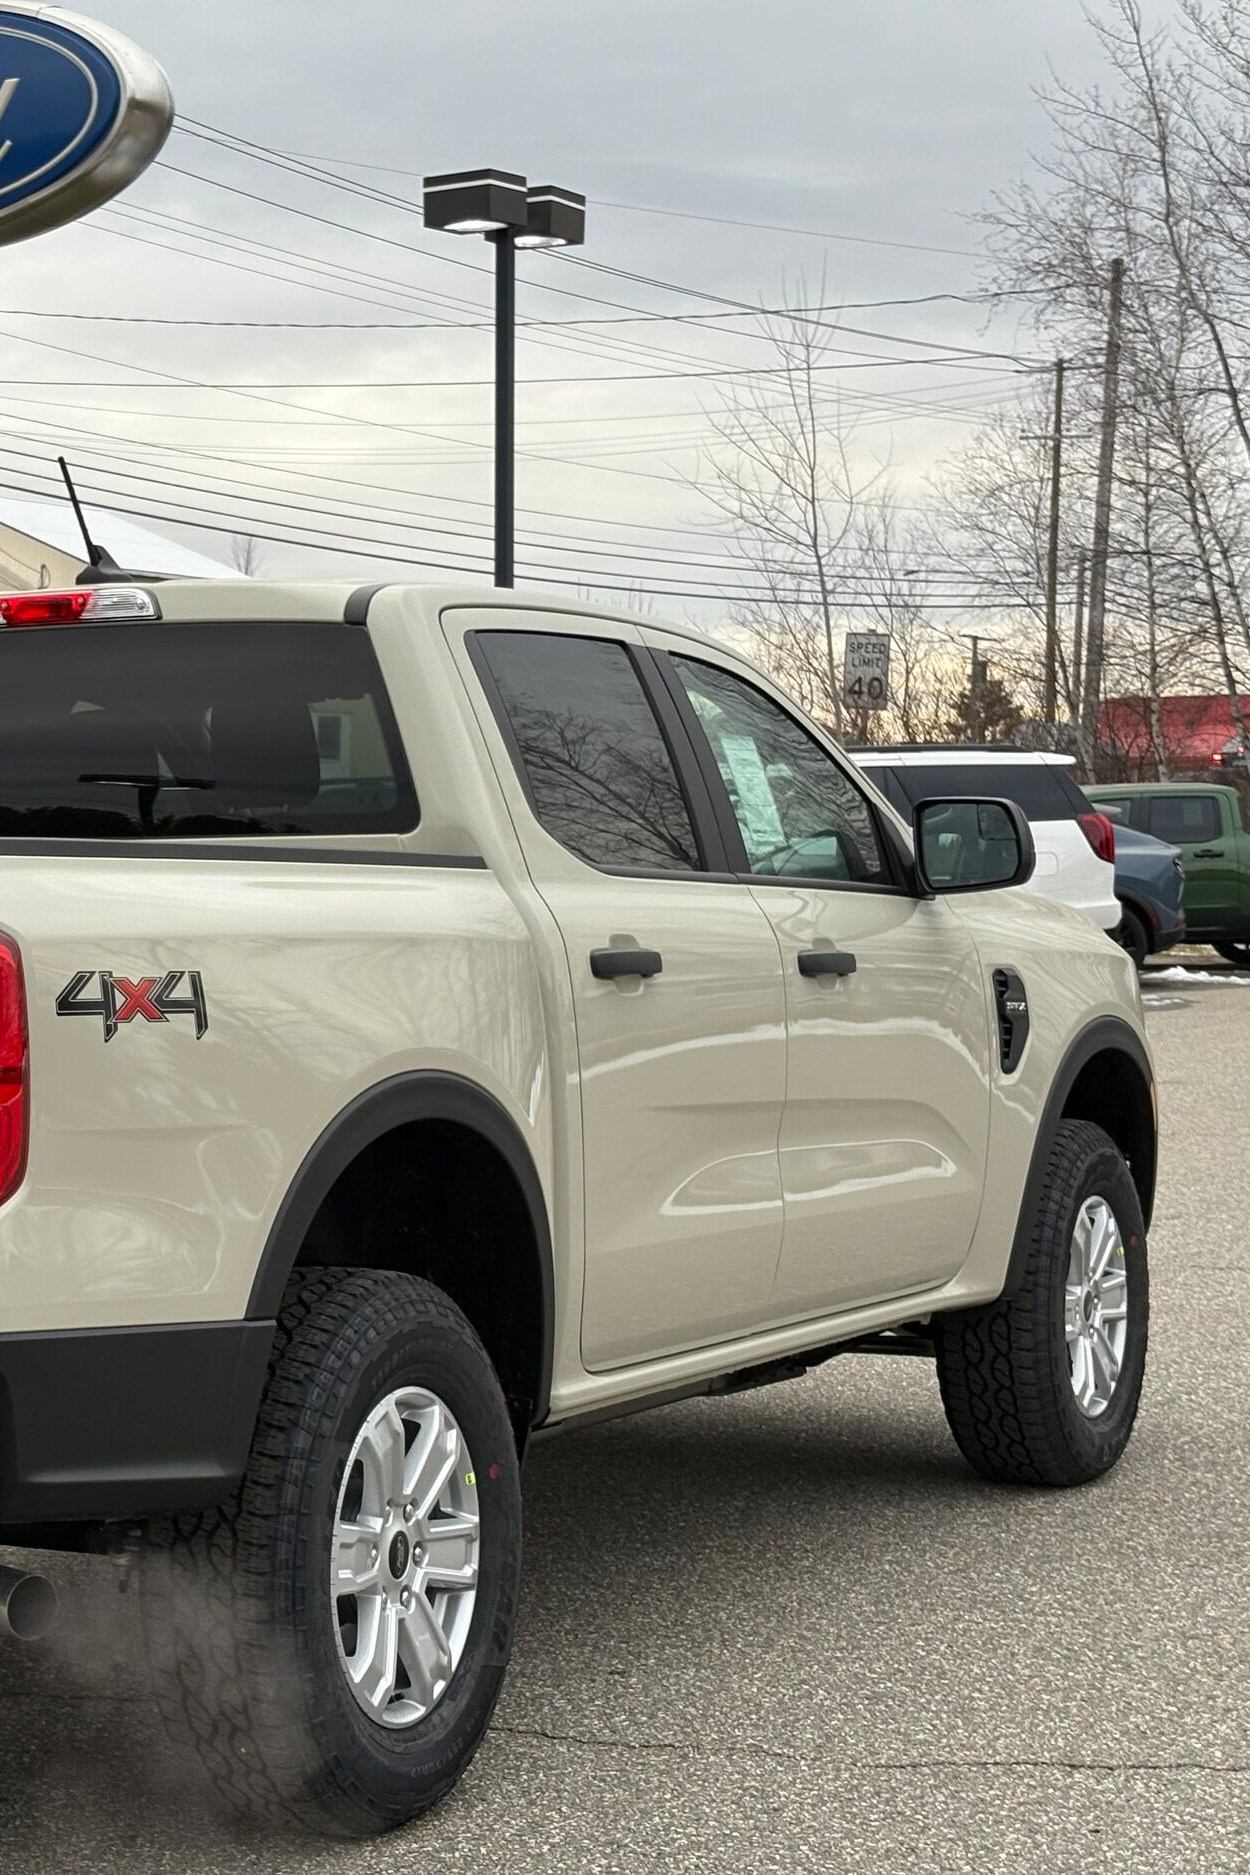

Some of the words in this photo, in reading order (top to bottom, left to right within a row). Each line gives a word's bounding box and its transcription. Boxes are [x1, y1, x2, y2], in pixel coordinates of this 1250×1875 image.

[848, 641, 887, 655] SPEED
[851, 656, 883, 669] LIMIT
[847, 675, 884, 701] 40
